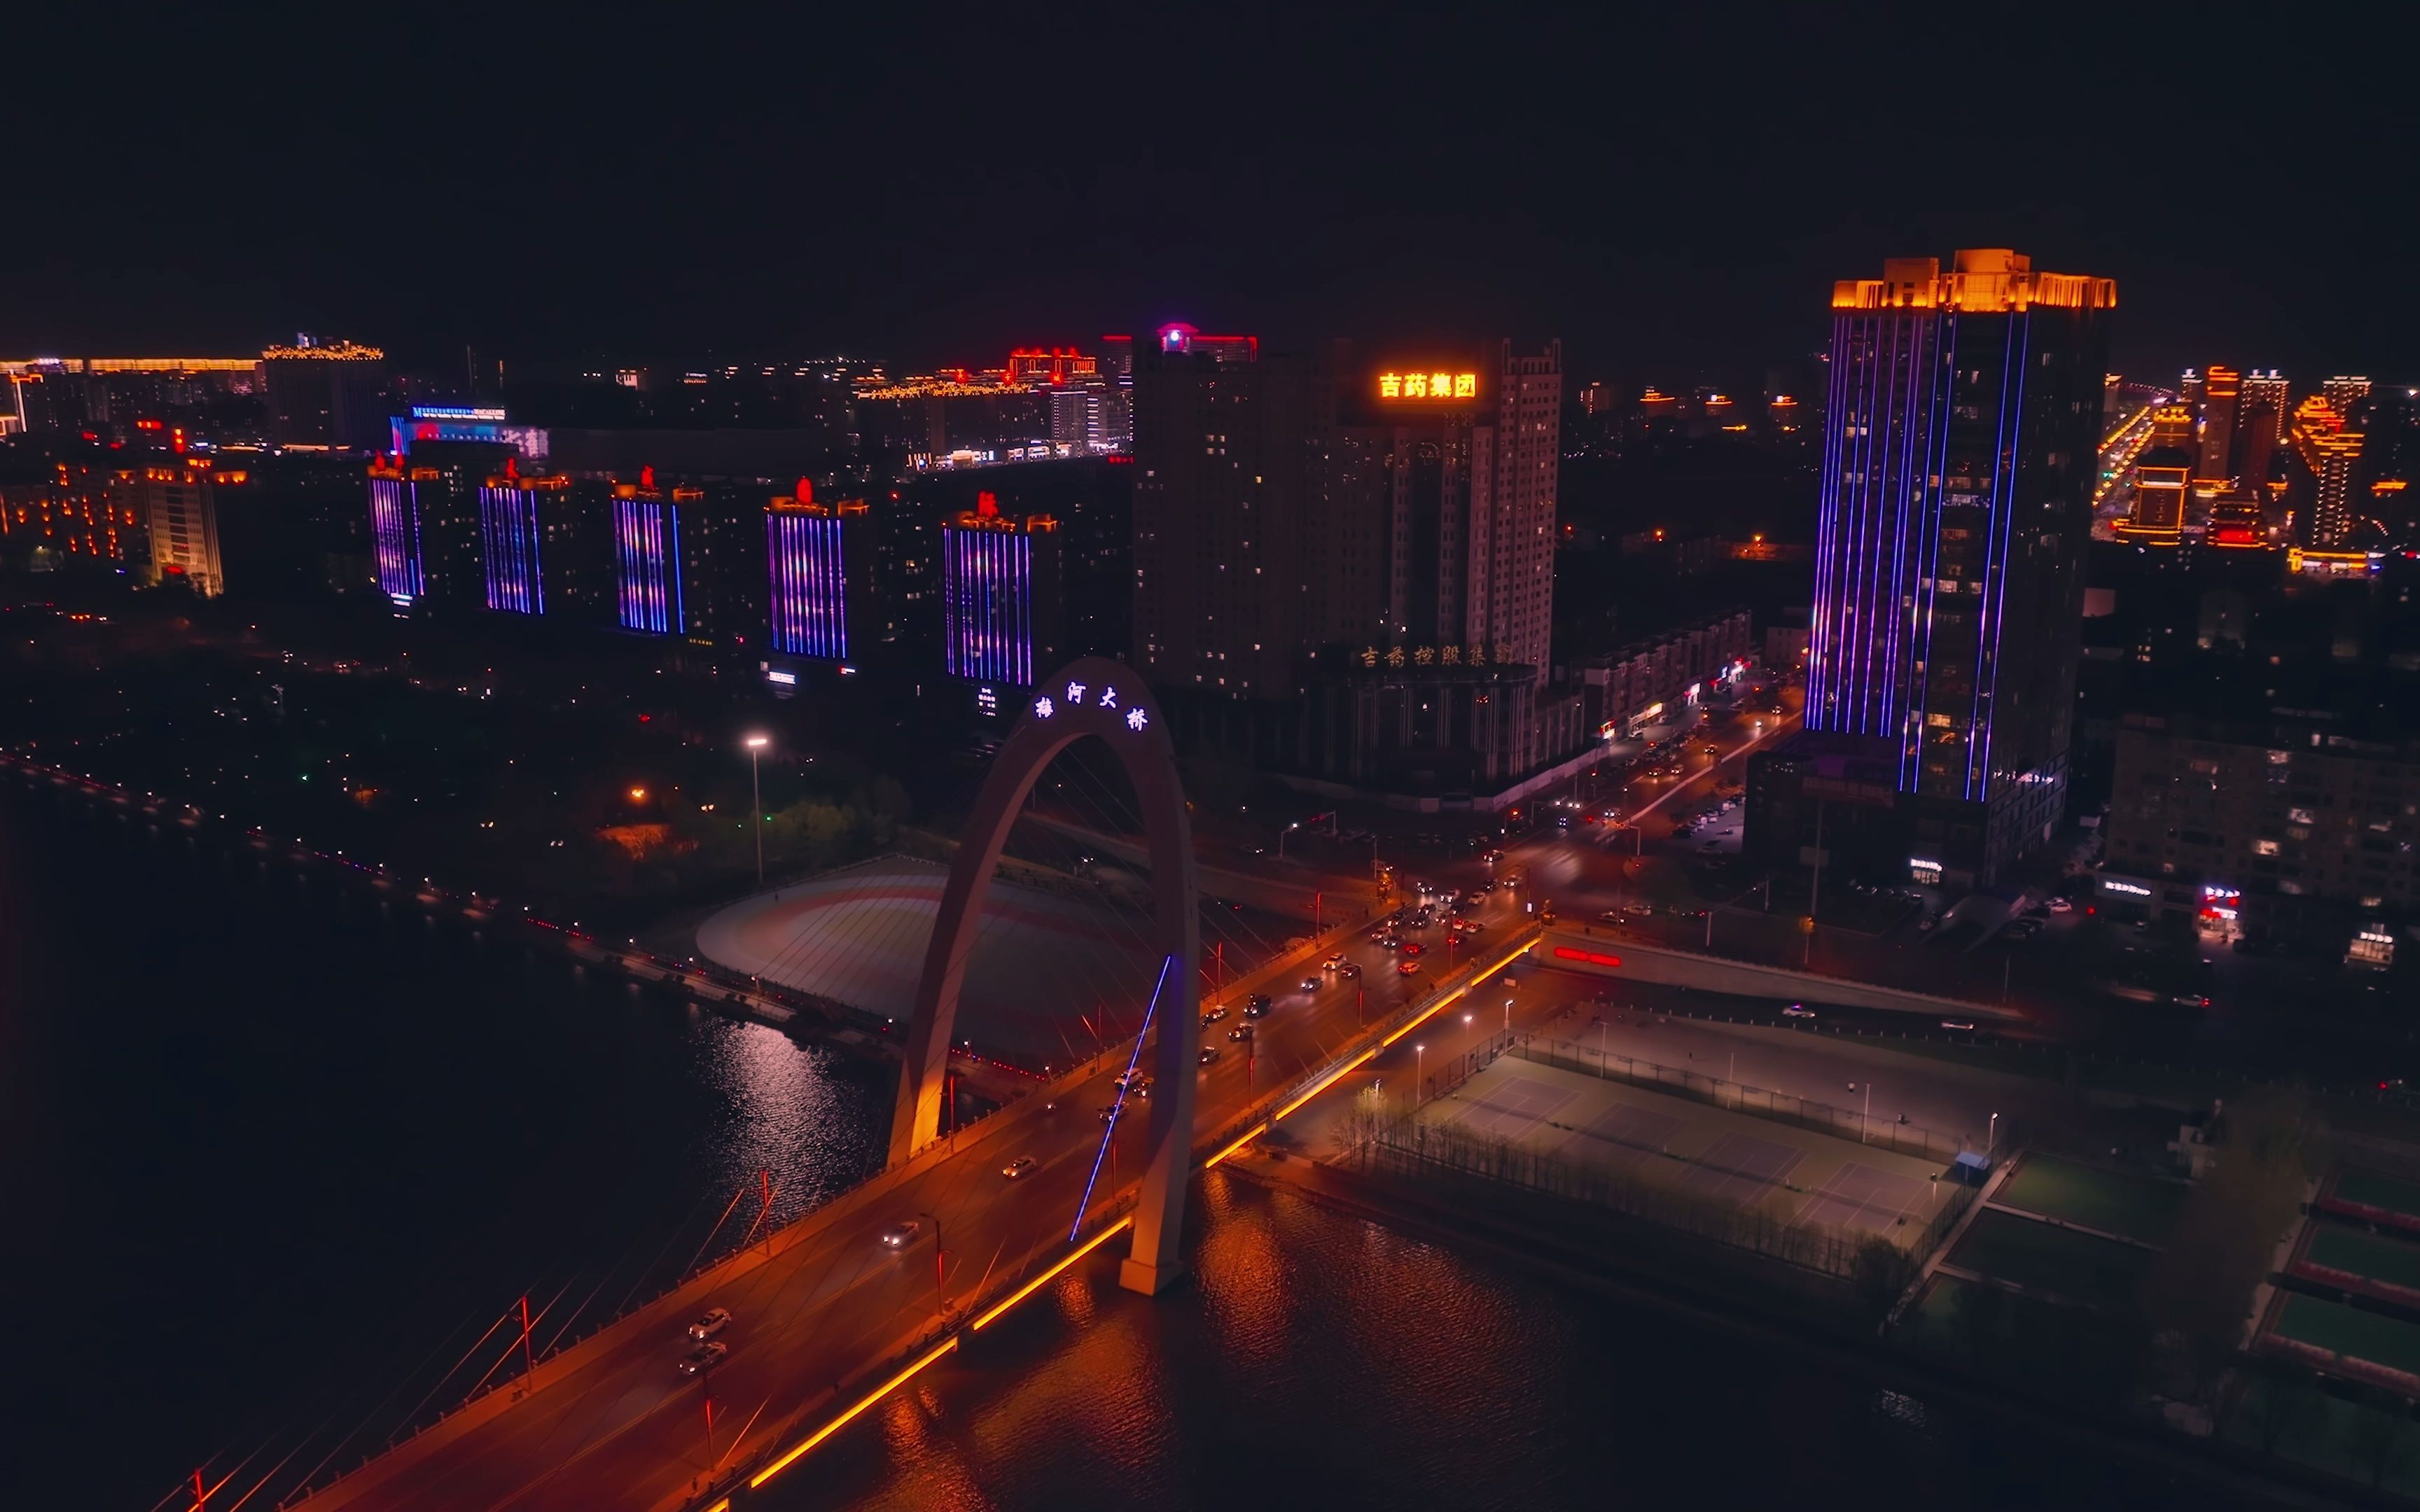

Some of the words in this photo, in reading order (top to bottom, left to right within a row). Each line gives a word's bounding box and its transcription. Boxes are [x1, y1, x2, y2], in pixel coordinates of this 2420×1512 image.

[1379, 373, 1477, 398] 吉药集团
[1035, 682, 1148, 732] 梅河大桥
